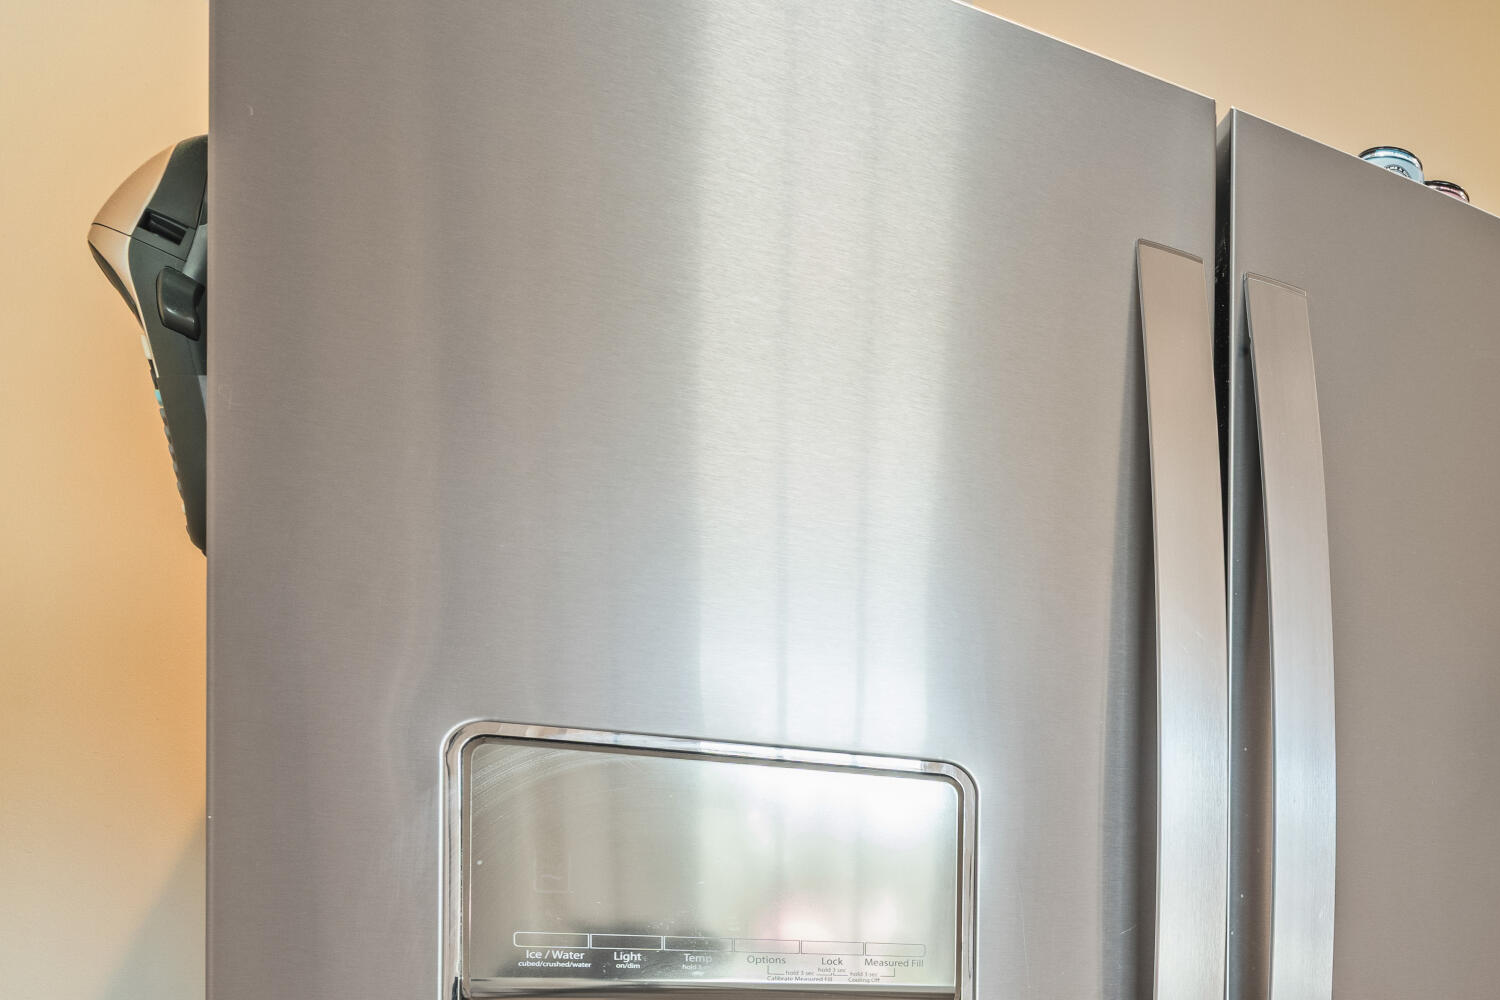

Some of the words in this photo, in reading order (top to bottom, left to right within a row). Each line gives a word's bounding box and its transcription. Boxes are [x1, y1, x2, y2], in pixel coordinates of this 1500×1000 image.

[526, 950, 542, 959] Ice
[551, 950, 585, 960] Water
[614, 952, 641, 963] Light
[684, 953, 713, 963] Temp
[747, 955, 786, 965] Options
[518, 960, 592, 968] cubed/crushed/water
[822, 957, 843, 966] Lock
[865, 958, 909, 968] Measured
[911, 959, 924, 967] Fill
